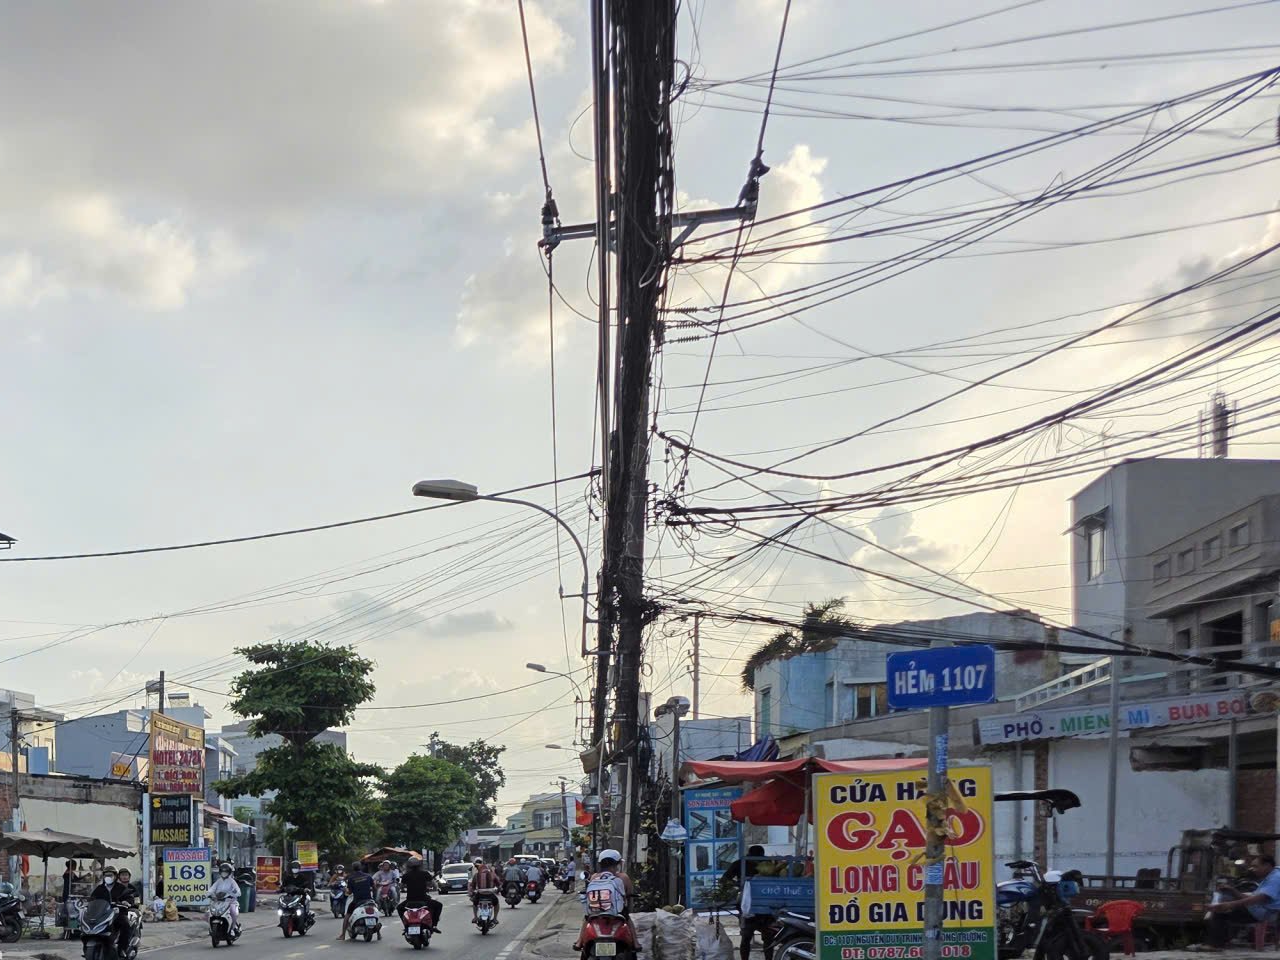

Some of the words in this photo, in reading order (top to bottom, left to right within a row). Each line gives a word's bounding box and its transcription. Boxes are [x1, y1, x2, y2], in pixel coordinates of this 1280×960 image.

[895, 661, 935, 695] HẺM
[942, 664, 987, 692] 1107
[830, 778, 886, 803] CỬA
[896, 777, 976, 800] HG
[152, 828, 189, 842] MASSAGE
[825, 808, 984, 861] GẠO
[167, 850, 208, 861] MASSAGE
[169, 865, 206, 880] 168
[830, 864, 900, 894] LONG
[906, 856, 980, 892] CÂU
[829, 897, 860, 924] ĐỒ
[869, 902, 908, 923] GIA
[838, 935, 854, 945] 1107
[885, 934, 900, 944] DUY
[957, 930, 987, 942] TRƯỜNG
[842, 948, 865, 959] ĐT:
